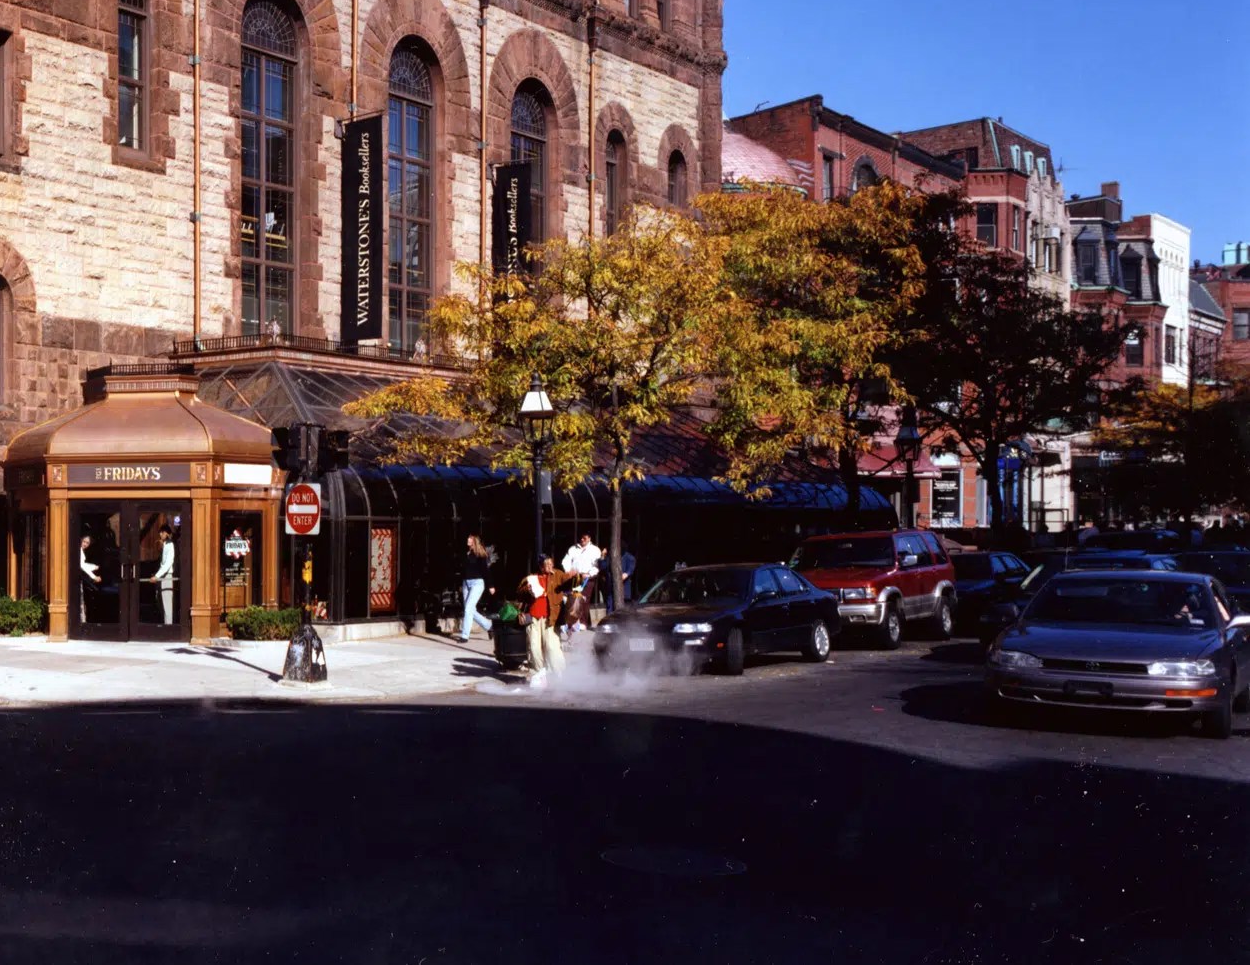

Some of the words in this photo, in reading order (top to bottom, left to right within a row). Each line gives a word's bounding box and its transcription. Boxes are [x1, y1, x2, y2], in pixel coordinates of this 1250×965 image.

[358, 132, 370, 195] Booksellers
[356, 198, 370, 327] WATERSTONE'S
[291, 493, 300, 503] DO
[302, 492, 314, 503] NOT
[292, 515, 312, 525] ENTER
